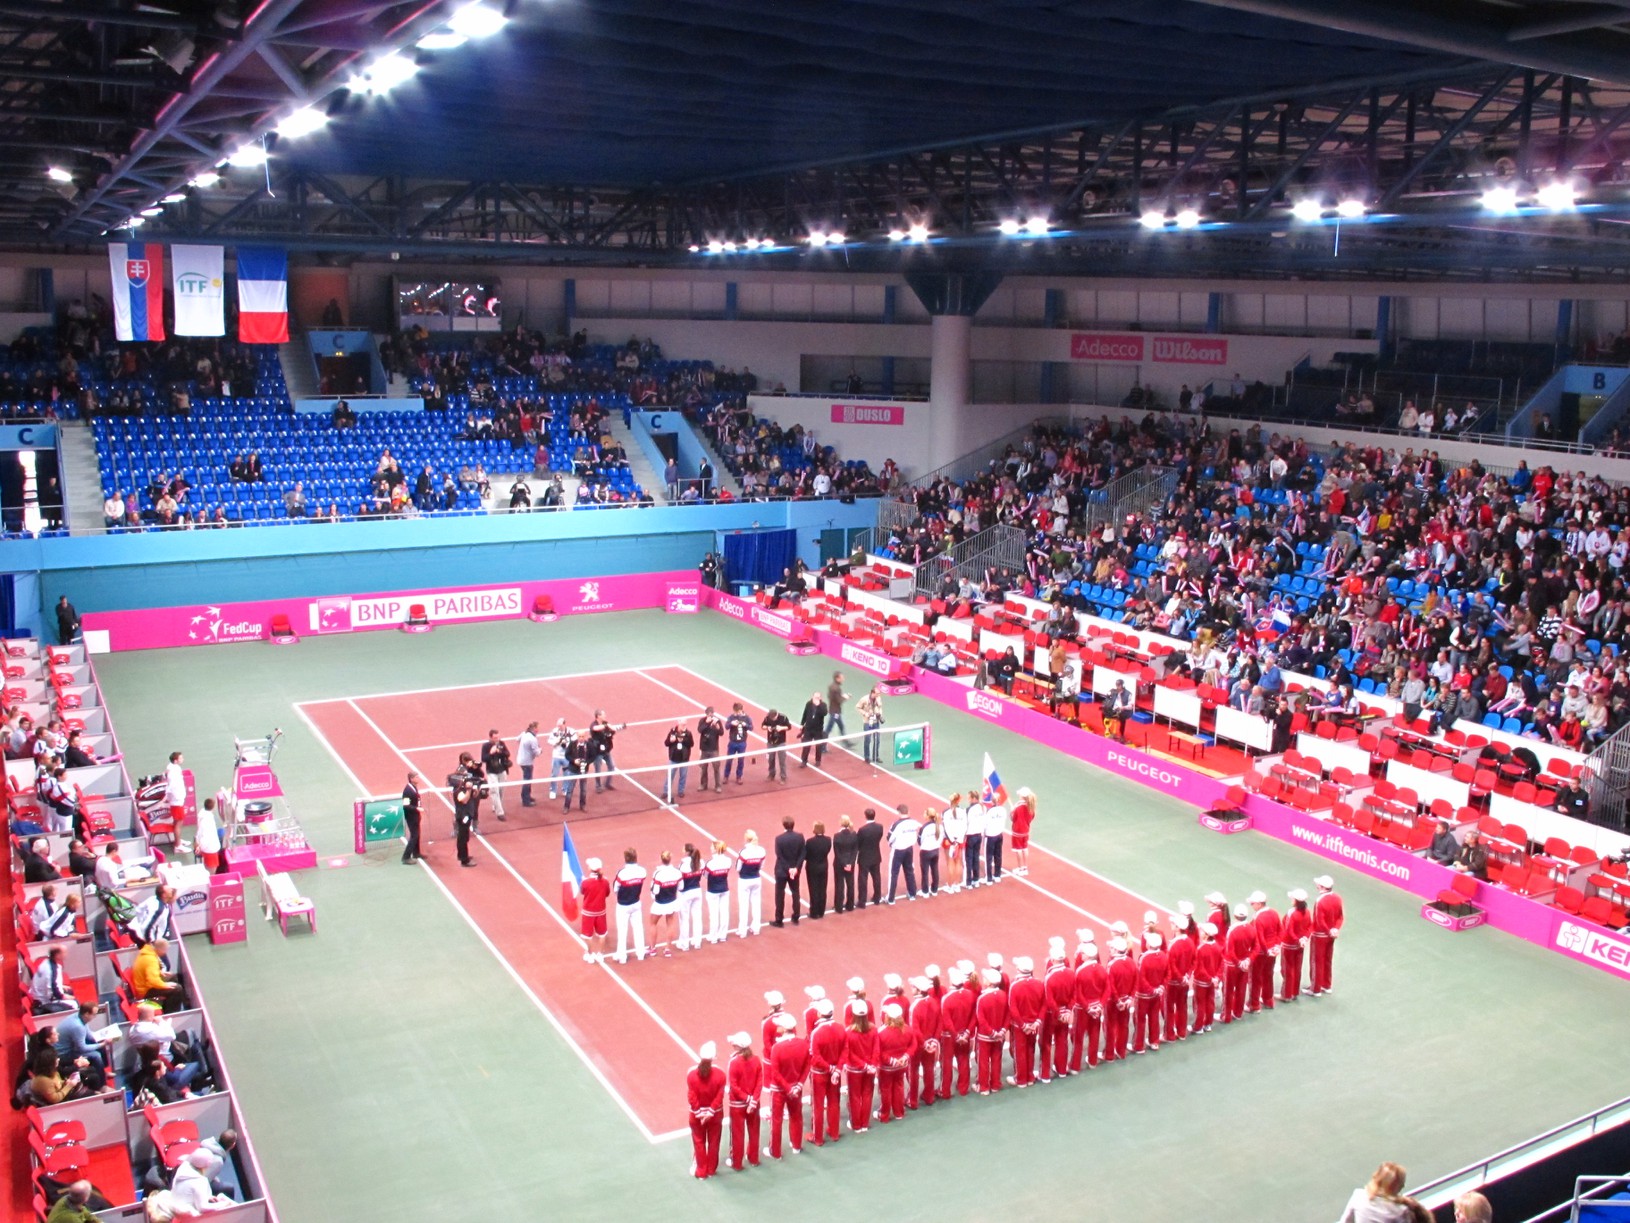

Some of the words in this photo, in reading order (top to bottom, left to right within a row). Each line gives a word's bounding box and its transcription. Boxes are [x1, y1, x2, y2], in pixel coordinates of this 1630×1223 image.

[180, 279, 207, 293] ITF
[333, 334, 345, 349] C
[1076, 338, 1139, 357] Adecco
[1154, 340, 1222, 361] Wilson
[1593, 372, 1606, 390] B
[651, 414, 662, 429] C
[856, 408, 891, 422] DUSLO
[18, 428, 34, 445] C
[668, 587, 698, 595] Adecco
[358, 602, 400, 621] BNP
[434, 593, 518, 615] PARIBAS
[572, 603, 614, 611] PEUGEOT
[719, 597, 744, 618] Adecco
[223, 621, 262, 635] FedCup
[852, 650, 875, 667] KENO
[877, 660, 888, 672] 10
[1107, 751, 1182, 788] PEUGEOT
[1292, 825, 1410, 880] www.itftennis.com
[215, 899, 233, 909] ITF
[217, 923, 235, 933] ITF
